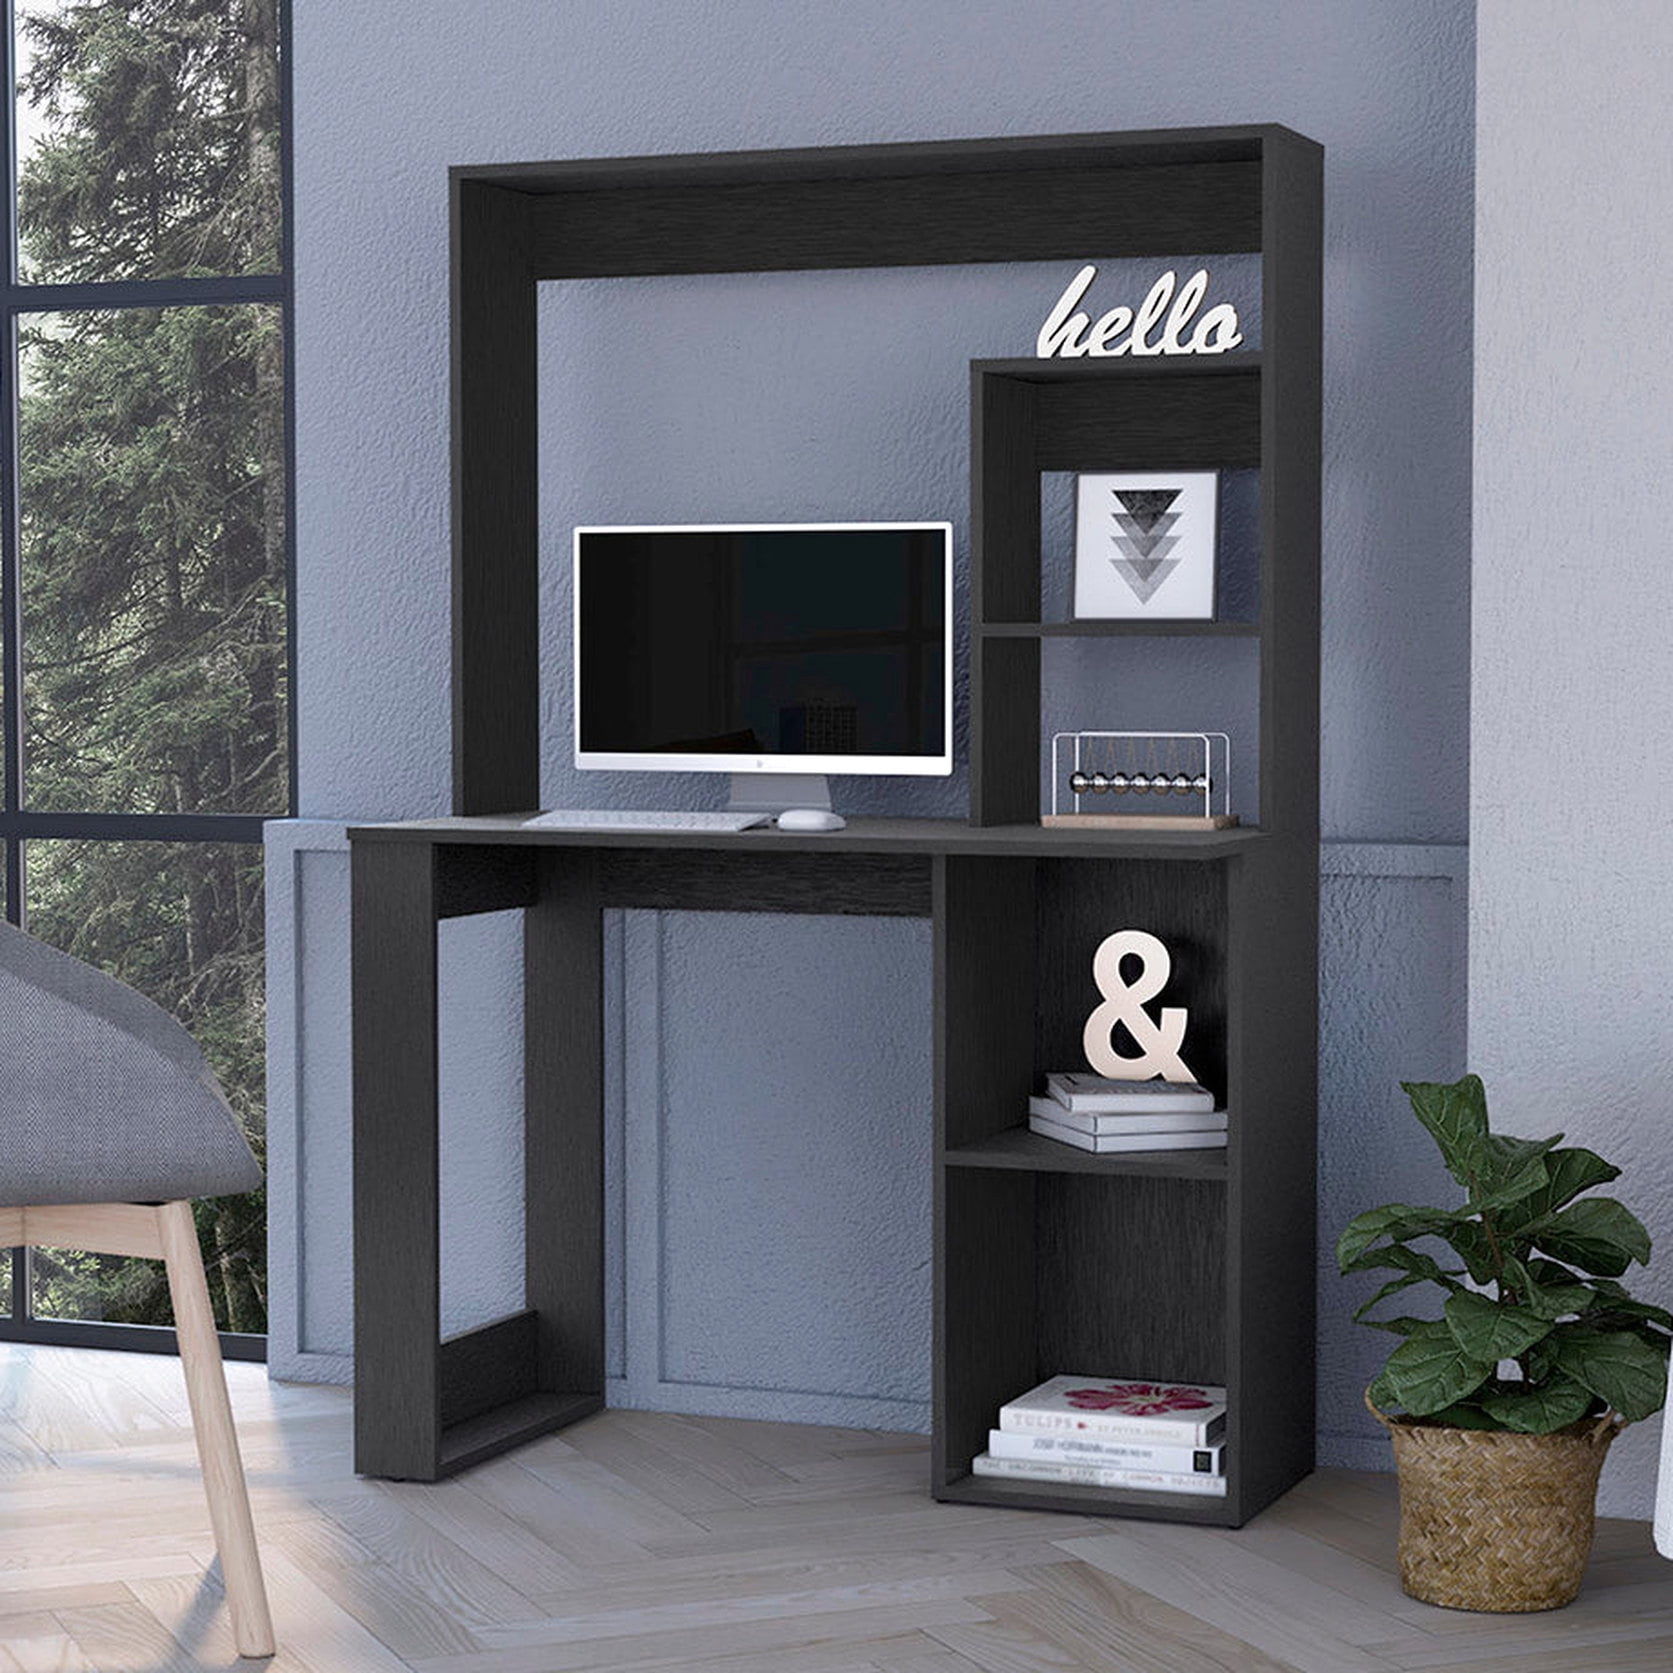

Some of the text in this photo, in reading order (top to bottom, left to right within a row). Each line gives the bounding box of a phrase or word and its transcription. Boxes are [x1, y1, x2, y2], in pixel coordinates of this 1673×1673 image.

[1036, 265, 1243, 359] hello
[1083, 929, 1198, 1083] &
[1013, 1412, 1072, 1429] TULIPS
